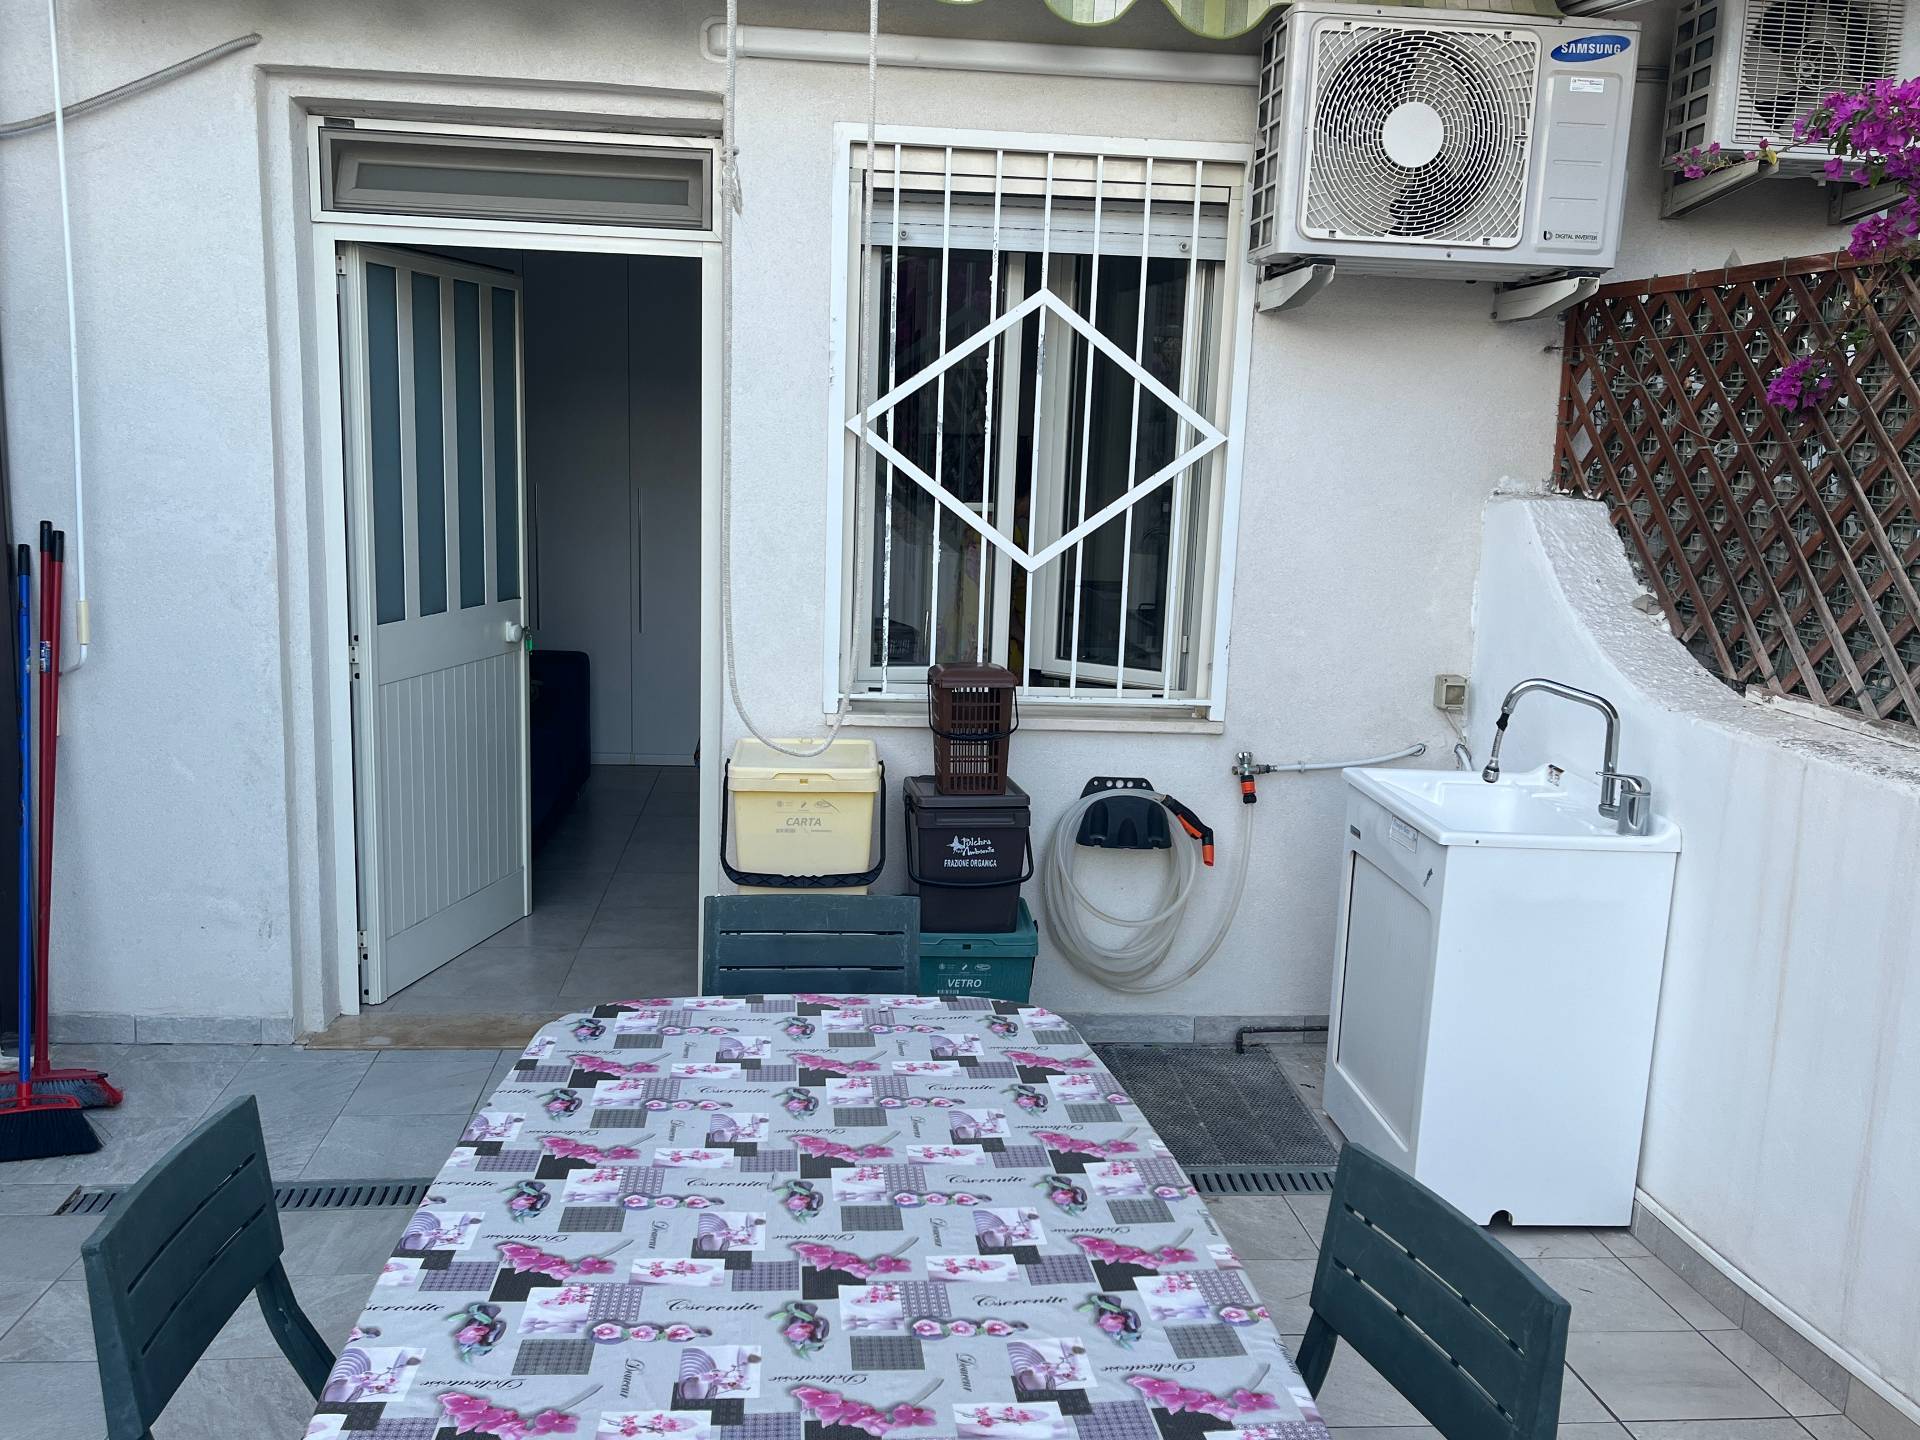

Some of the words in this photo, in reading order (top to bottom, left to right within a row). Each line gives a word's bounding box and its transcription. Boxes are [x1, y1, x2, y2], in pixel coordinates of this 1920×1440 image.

[1561, 43, 1621, 54] SAMSUNG
[786, 817, 822, 827] CARTA
[943, 859, 970, 868] FRAZIONE
[970, 859, 998, 868] ORGANICA
[947, 979, 982, 988] VETRO
[956, 1352, 977, 1393] Douceur
[620, 1357, 645, 1399] Douceur
